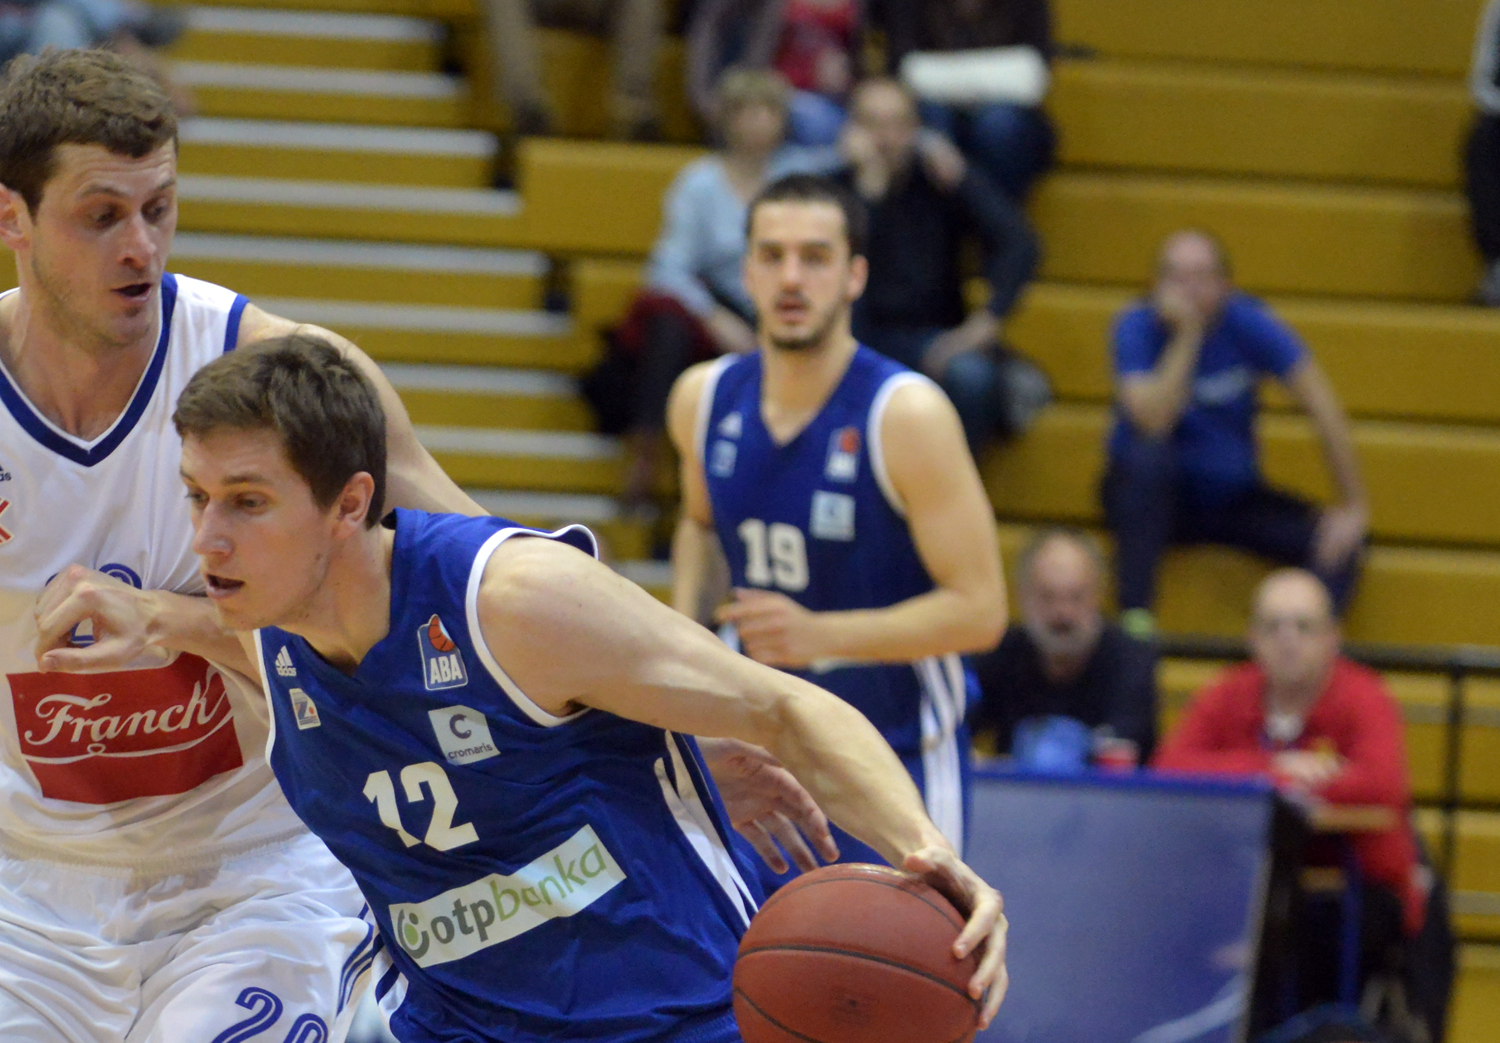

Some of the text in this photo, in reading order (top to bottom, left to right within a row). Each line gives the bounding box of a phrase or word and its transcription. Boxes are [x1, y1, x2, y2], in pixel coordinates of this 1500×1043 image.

[737, 517, 810, 590] 19
[430, 653, 463, 684] ABA
[24, 665, 229, 746] Franck
[448, 742, 493, 759] cromaris
[362, 761, 480, 852] 12
